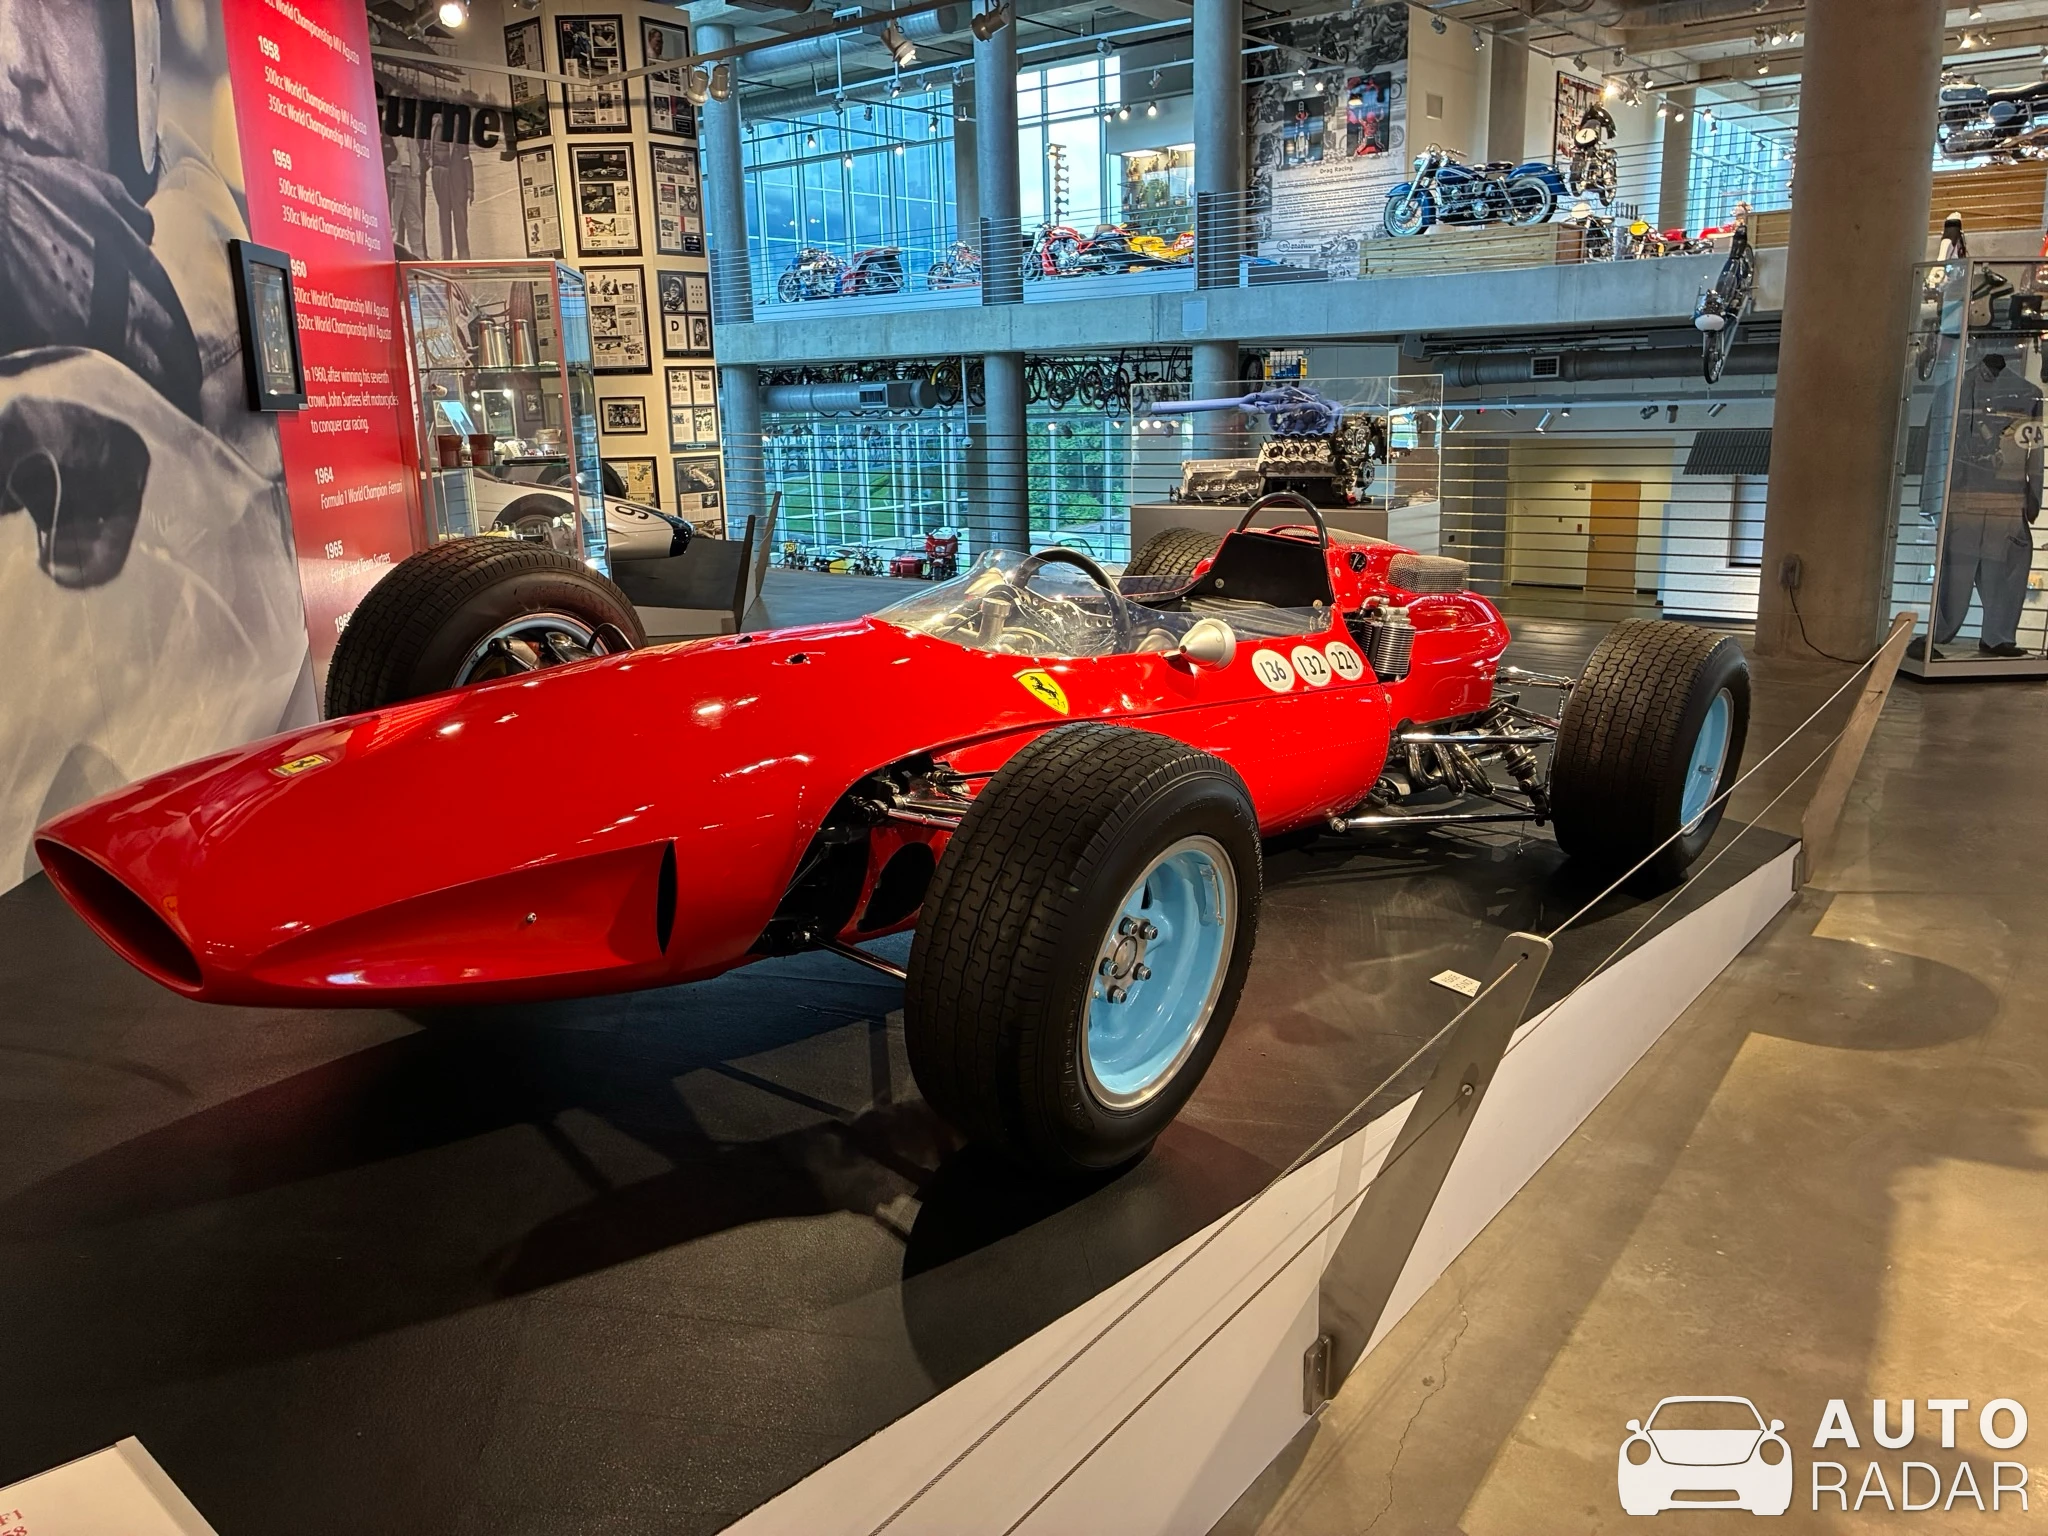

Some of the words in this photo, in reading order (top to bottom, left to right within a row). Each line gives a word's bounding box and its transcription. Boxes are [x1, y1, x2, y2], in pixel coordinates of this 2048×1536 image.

[294, 8, 333, 50] Championship
[258, 35, 280, 62] 1958
[265, 66, 284, 90] 500cc
[283, 76, 302, 100] World
[302, 86, 340, 124] Championship
[340, 108, 349, 126] MV
[350, 113, 367, 135] Agusta
[268, 93, 288, 117] 350cc
[287, 103, 305, 127] World
[305, 113, 343, 149] Championship
[343, 133, 352, 150] MV
[352, 138, 370, 159] Agusta
[272, 148, 292, 171] 1959
[279, 177, 297, 199] 500cc
[296, 183, 315, 205] World
[315, 191, 352, 222] Championship
[352, 205, 361, 221] MV
[361, 209, 378, 228] Agusta
[282, 204, 301, 226] 350cc
[300, 210, 318, 231] World
[319, 216, 356, 246] Championship
[355, 230, 364, 245] MV
[364, 232, 381, 251] Agusta
[290, 259, 307, 278] 960
[310, 289, 328, 308] World
[328, 293, 365, 317] Championship
[364, 300, 373, 315] MV
[373, 302, 389, 320] Agusta
[296, 313, 314, 330] 350cc
[313, 315, 332, 333] World
[331, 318, 367, 340] Championship
[367, 324, 375, 338] MV
[376, 325, 392, 342] Agusta
[303, 366, 310, 381] In
[311, 366, 328, 384] 1960,
[328, 366, 341, 382] after
[341, 368, 363, 387] winning
[362, 368, 371, 383] his
[371, 369, 389, 383] seventh
[307, 395, 328, 409] crown,
[328, 391, 342, 407] John
[342, 391, 361, 407] Surtees
[361, 391, 371, 406] left
[371, 391, 399, 409] motorcycles
[310, 419, 318, 433] to
[319, 419, 342, 436] conquer
[342, 418, 351, 431] car
[352, 415, 369, 433] racing.
[315, 466, 334, 484] 1964
[321, 490, 344, 509] Formula
[344, 489, 348, 504] 1
[347, 486, 364, 503] World
[363, 482, 388, 501] Champion
[388, 479, 403, 495] Ferrari
[325, 539, 343, 559] 1965
[330, 560, 360, 584] Established
[360, 557, 373, 572] Team
[373, 552, 391, 568] Surtees
[1260, 661, 1287, 682] 136
[1297, 656, 1326, 676] 132
[1331, 651, 1357, 670] 221
